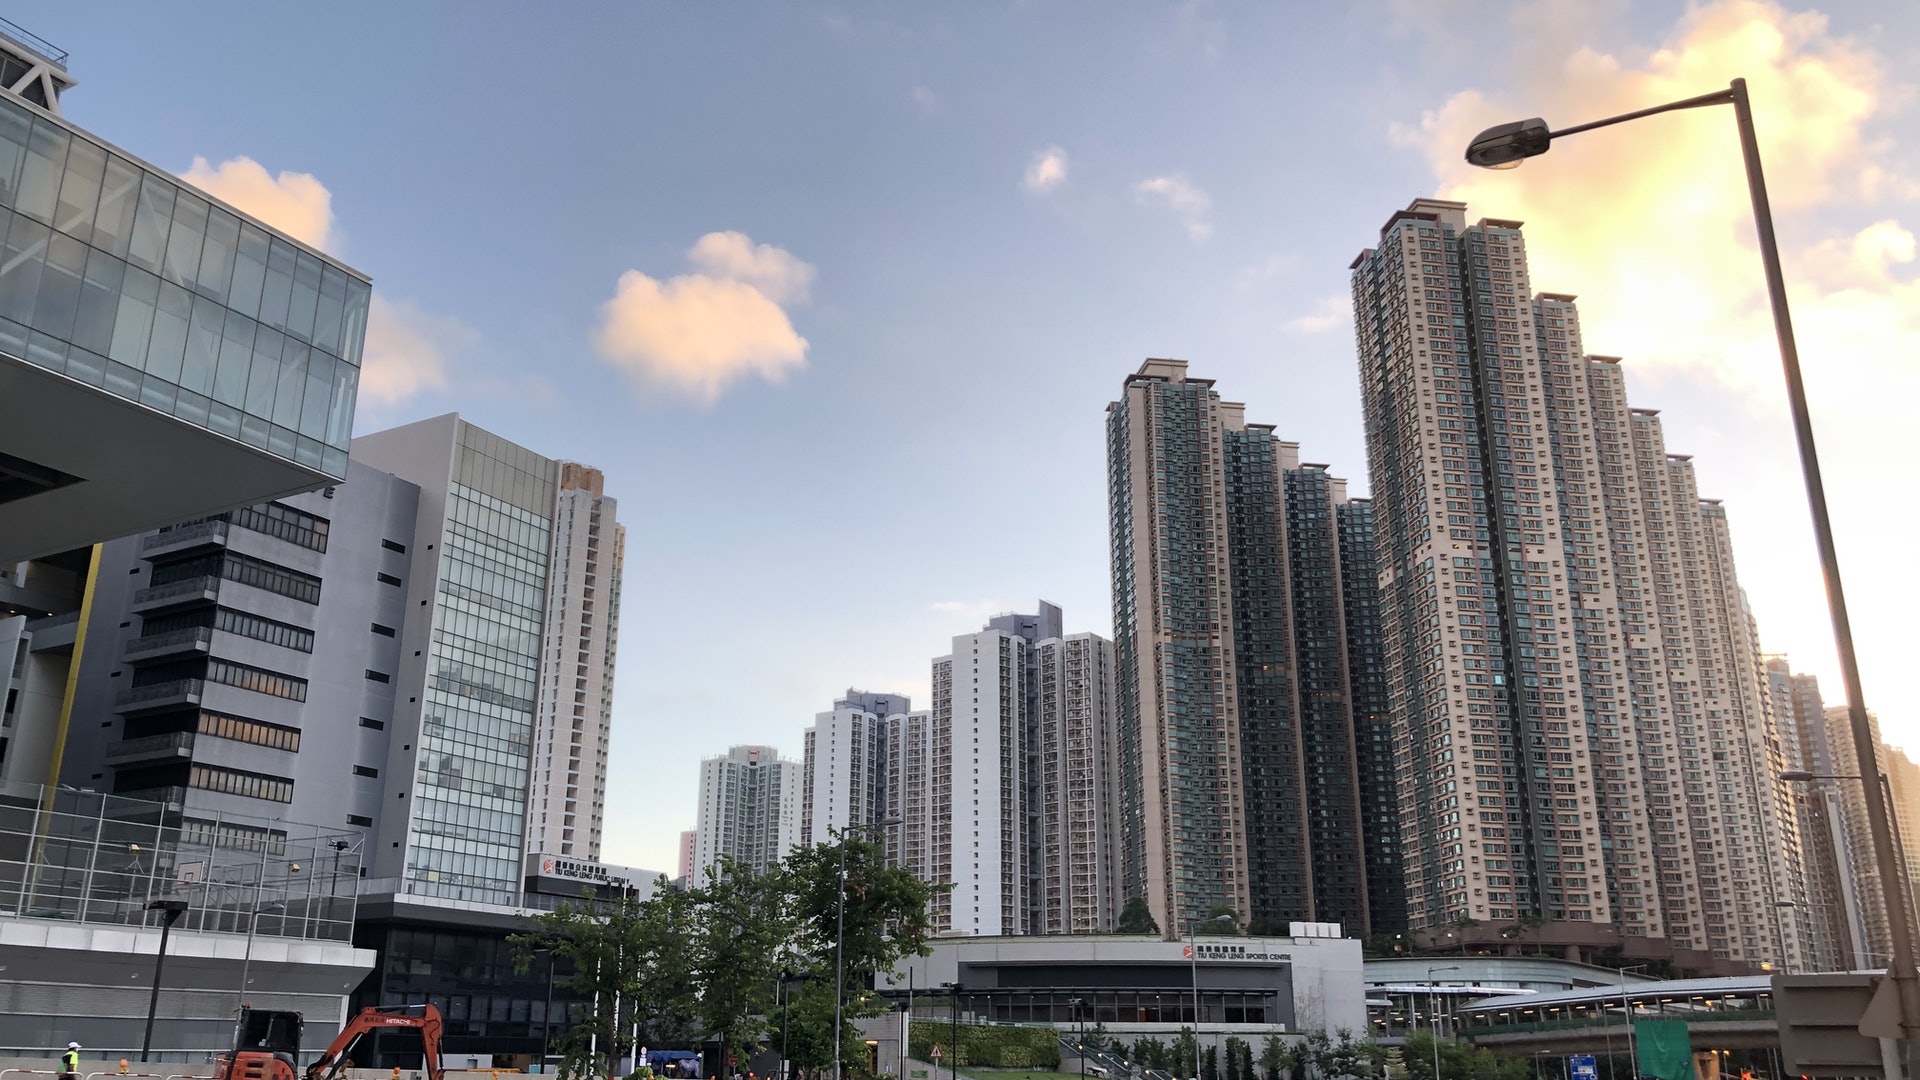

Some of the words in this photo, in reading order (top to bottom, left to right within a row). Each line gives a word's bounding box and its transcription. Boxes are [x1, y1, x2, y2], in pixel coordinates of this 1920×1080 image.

[564, 869, 578, 877] KENG
[579, 871, 593, 879] LENG
[593, 872, 610, 882] PUBLIC
[1228, 952, 1245, 960] LENG
[1269, 953, 1292, 961] CENTRE
